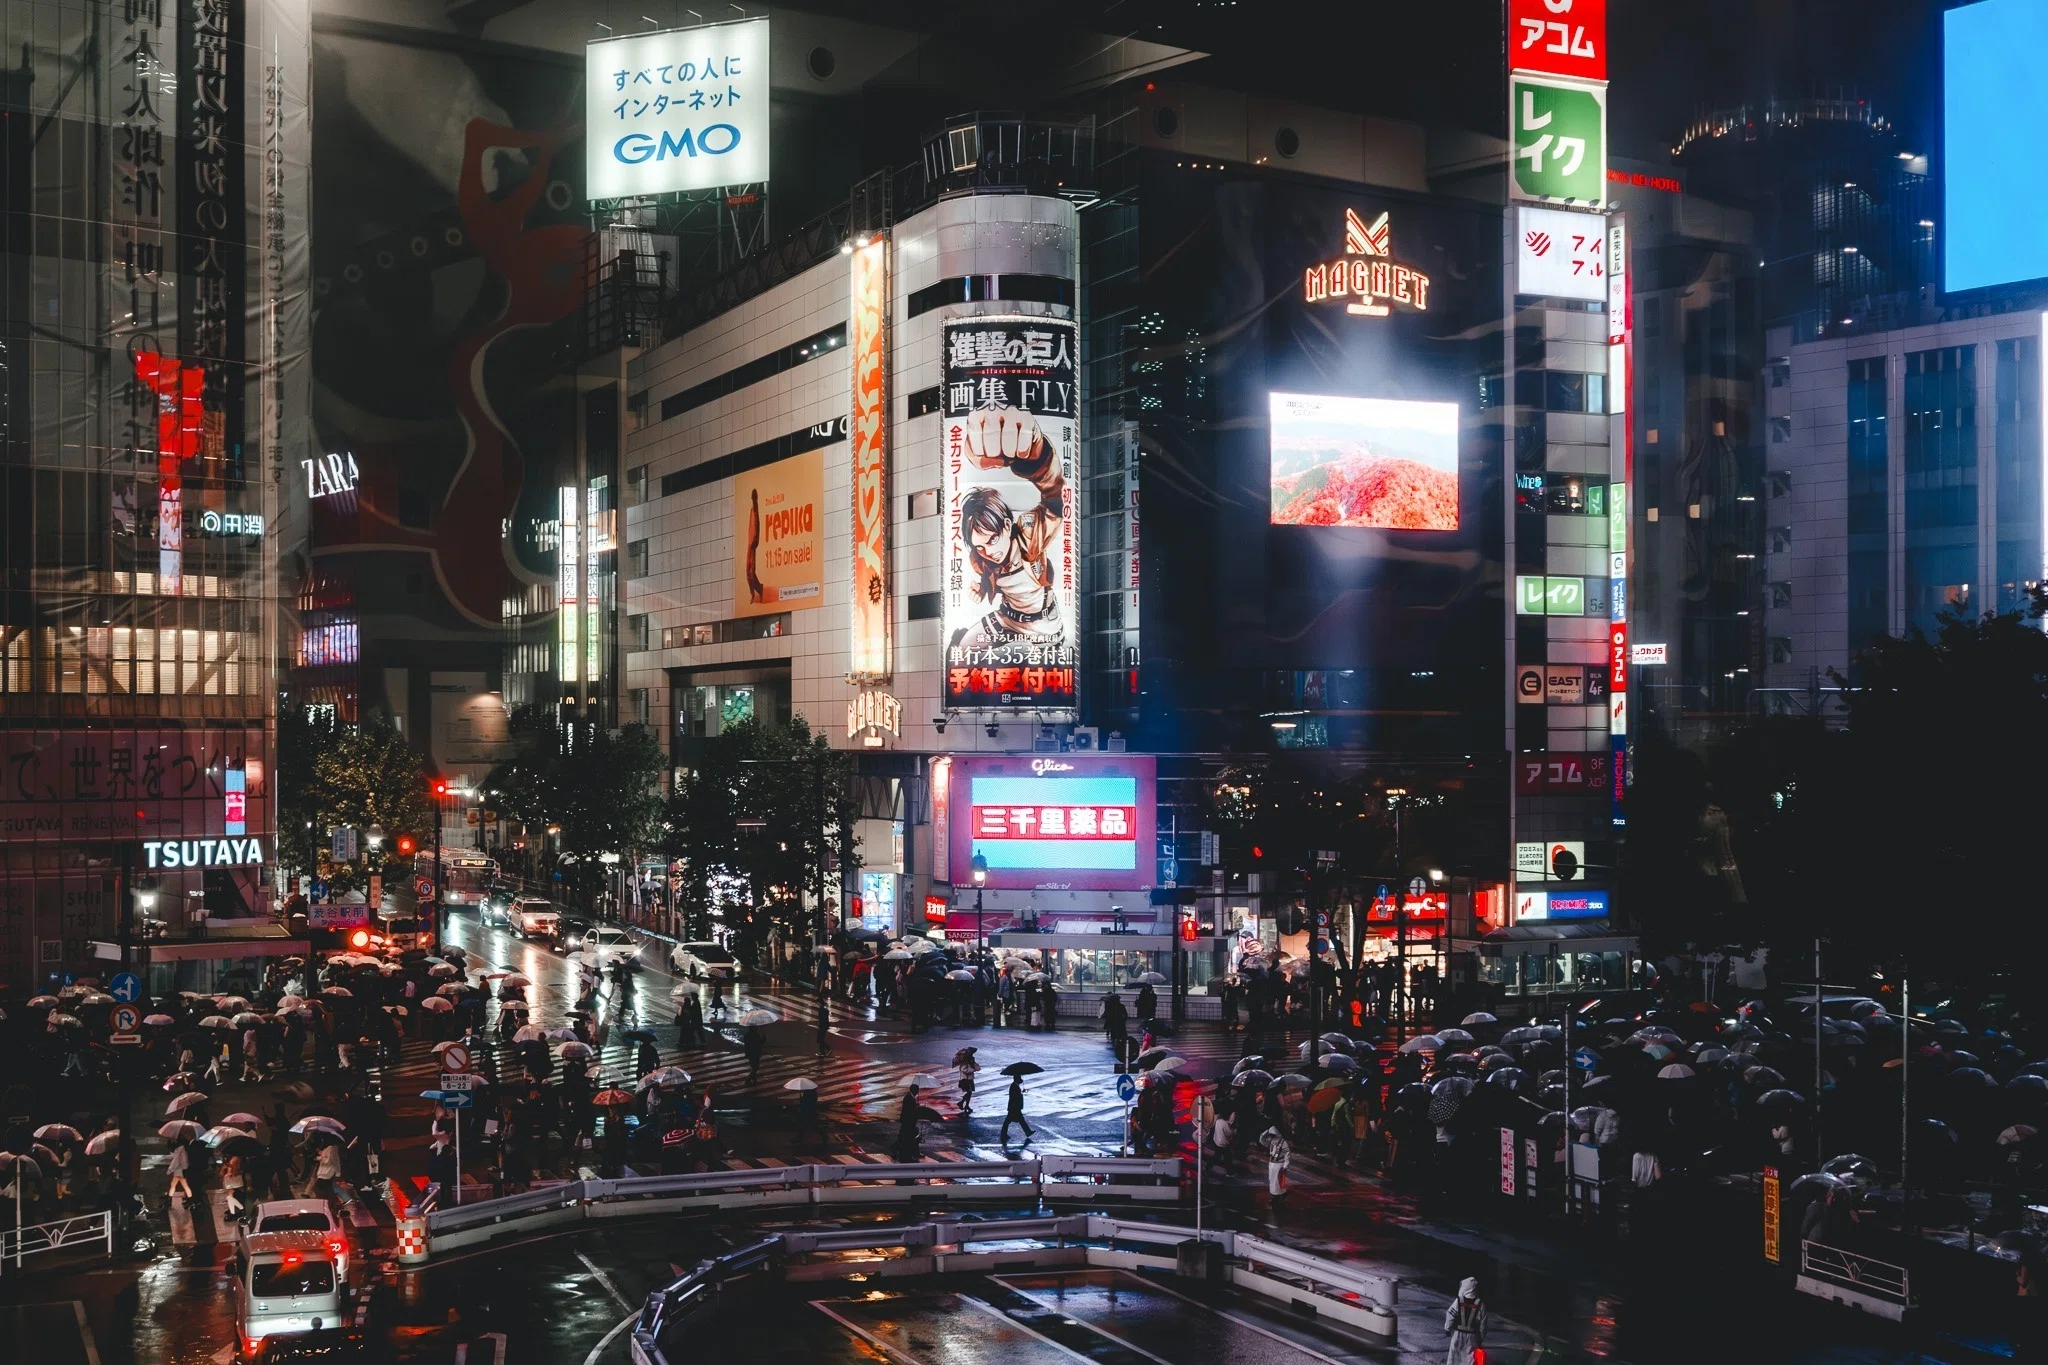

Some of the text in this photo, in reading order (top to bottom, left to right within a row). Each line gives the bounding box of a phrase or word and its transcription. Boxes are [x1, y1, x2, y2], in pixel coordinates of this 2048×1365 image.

[1520, 18, 1596, 59] アコム
[613, 56, 742, 91] すべての人に
[613, 85, 742, 119] インターネット
[613, 123, 742, 164] GMO
[1651, 177, 1682, 193] HOTEL
[1305, 260, 1430, 310] MAGNET
[949, 329, 1072, 371] 進撃の巨人
[949, 377, 1072, 414] 画集 FLY
[301, 451, 359, 498] ZARA
[1613, 489, 1622, 524] レイク
[783, 548, 793, 565] on
[794, 540, 814, 564] sale!
[1527, 583, 1579, 604] レイク
[1614, 647, 1624, 683] アコム
[949, 667, 1073, 694] 予約受付中!!
[1548, 676, 1582, 687] EAST
[1588, 681, 1602, 696] 4F
[847, 691, 904, 739] MAGNET
[1031, 759, 1075, 777] Glico
[1526, 763, 1583, 784] アコム
[1591, 758, 1605, 770] 3F
[980, 808, 1128, 835] 三千里薬品
[143, 839, 263, 868] TSUTAYA
[313, 907, 364, 919] 渋谷駅前
